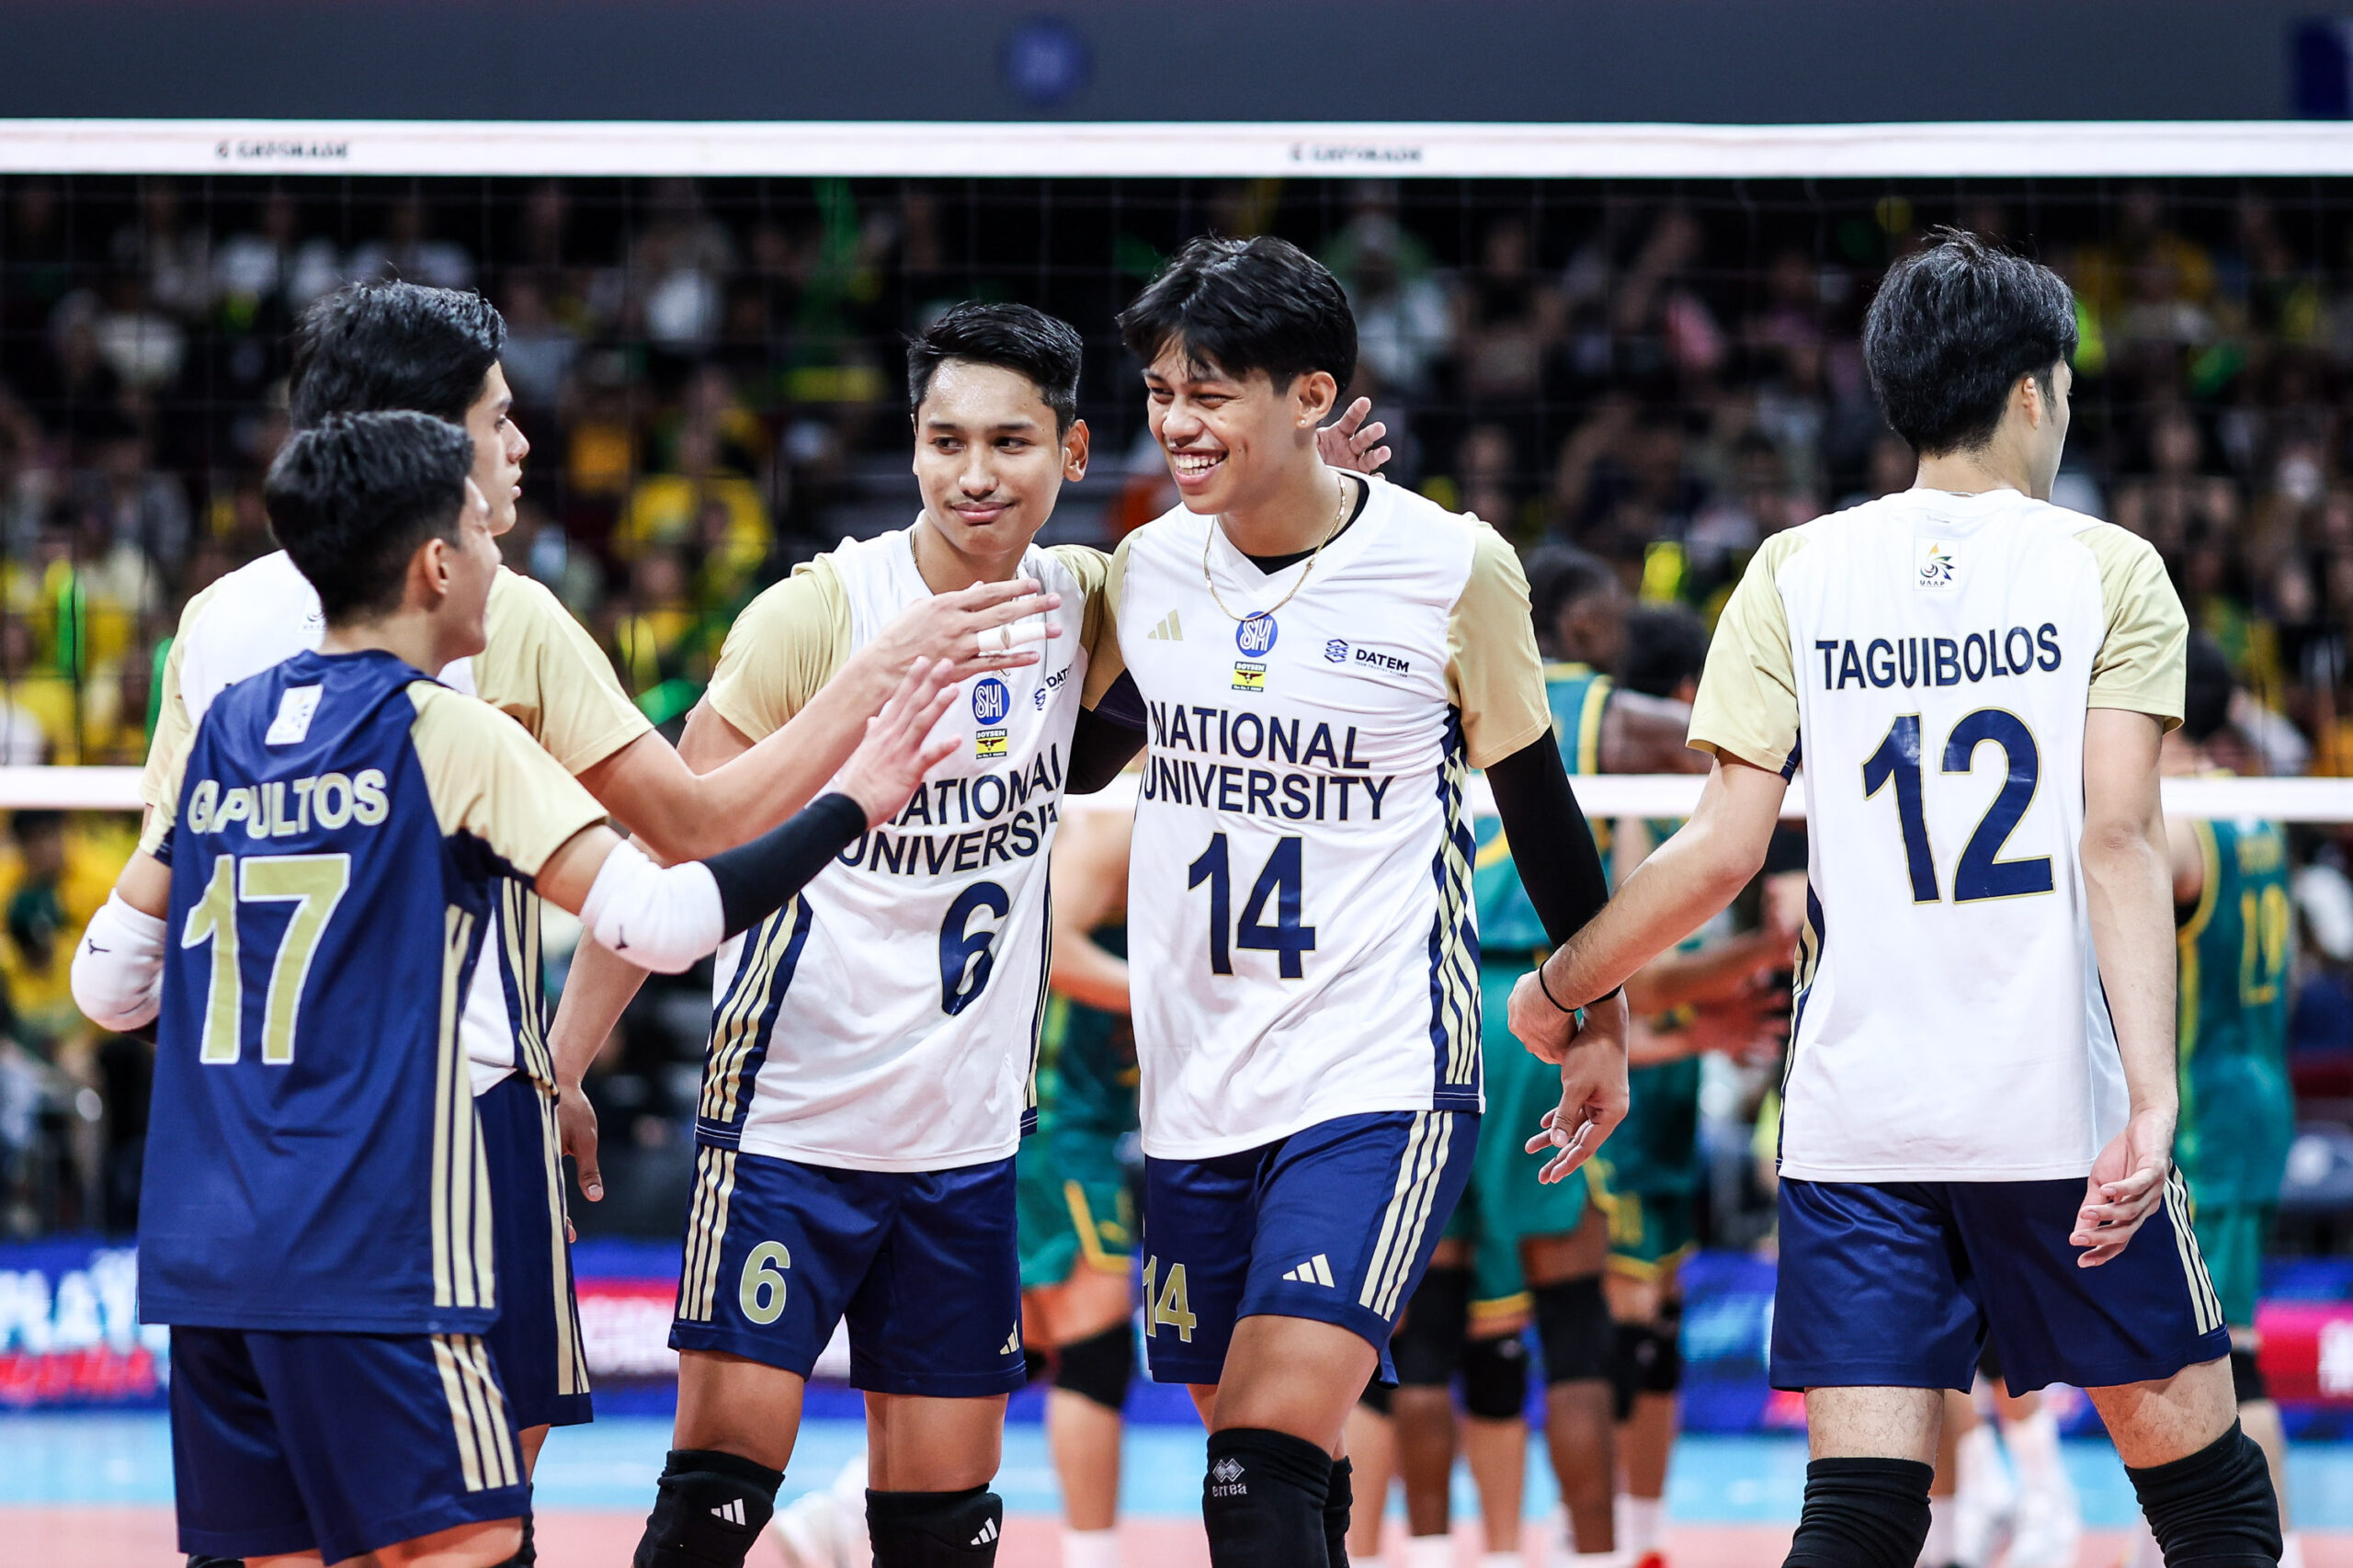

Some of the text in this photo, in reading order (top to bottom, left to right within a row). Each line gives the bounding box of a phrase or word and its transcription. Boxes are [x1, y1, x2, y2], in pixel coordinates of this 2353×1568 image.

[1235, 663, 1266, 672] BOYSEN
[1239, 618, 1274, 652] SM
[1356, 648, 1410, 673] DATEM
[1815, 622, 2062, 690] TAGUIBOLOS
[974, 684, 1004, 719] SM
[1046, 663, 1073, 687] DAT
[977, 730, 1006, 739] BOYSEN
[1149, 700, 1370, 769] NATIONAL
[886, 743, 1063, 827] ATIONAL
[1144, 755, 1396, 822] UNIVERSITY
[1859, 706, 2056, 905] 12
[836, 801, 1060, 875] UNIVERSI
[1188, 831, 1315, 980] 14
[181, 852, 351, 1065] 17
[938, 880, 1010, 1017] 6
[739, 1241, 791, 1324] 6
[1142, 1255, 1197, 1343] 14
